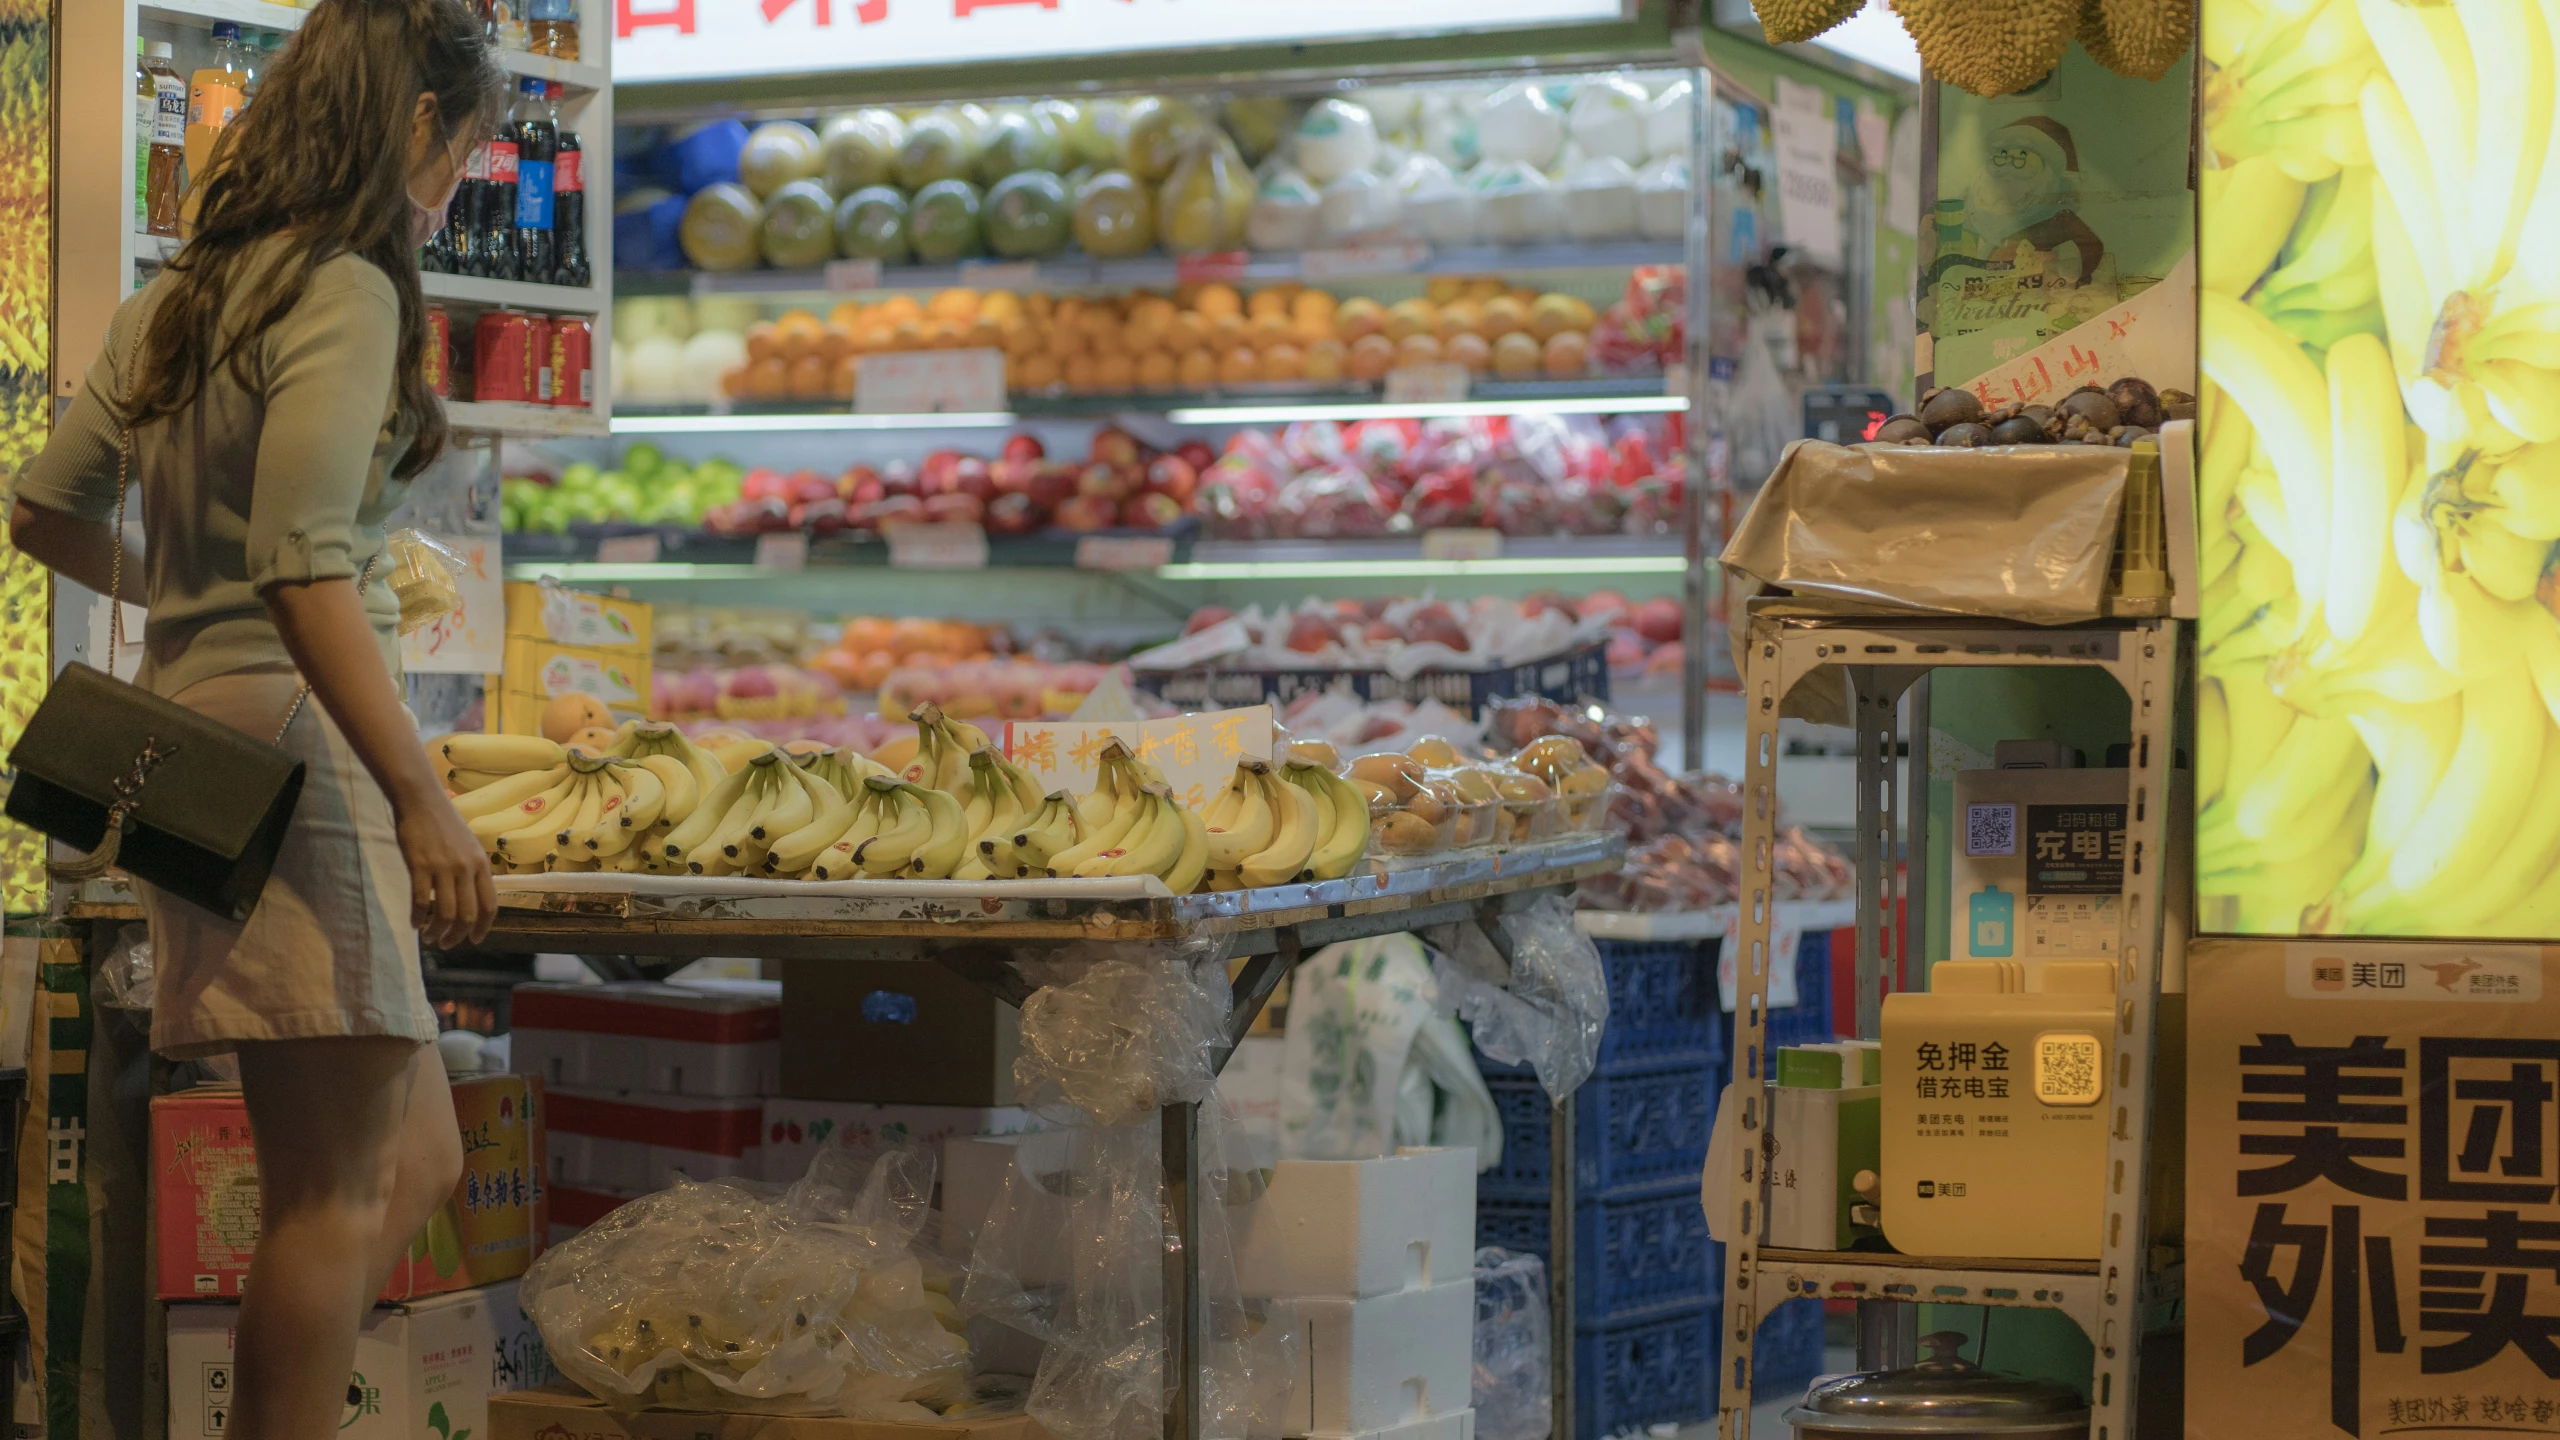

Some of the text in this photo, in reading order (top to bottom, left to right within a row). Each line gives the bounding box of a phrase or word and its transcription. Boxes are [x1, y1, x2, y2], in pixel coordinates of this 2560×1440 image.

[2057, 813, 2118, 828] 扫码租借
[2315, 962, 2519, 988] 美团 美团 美团外卖
[1917, 1042, 2010, 1071] 免押金
[1917, 1076, 2010, 1099] 借充电宝
[1917, 1114, 1965, 1125] 美团充电
[2238, 1033, 2560, 1202] 美团
[1938, 1183, 1966, 1196] 美团
[2238, 1203, 2560, 1439] 外卖
[2388, 1396, 2560, 1425] 美团外卖 送啥都
